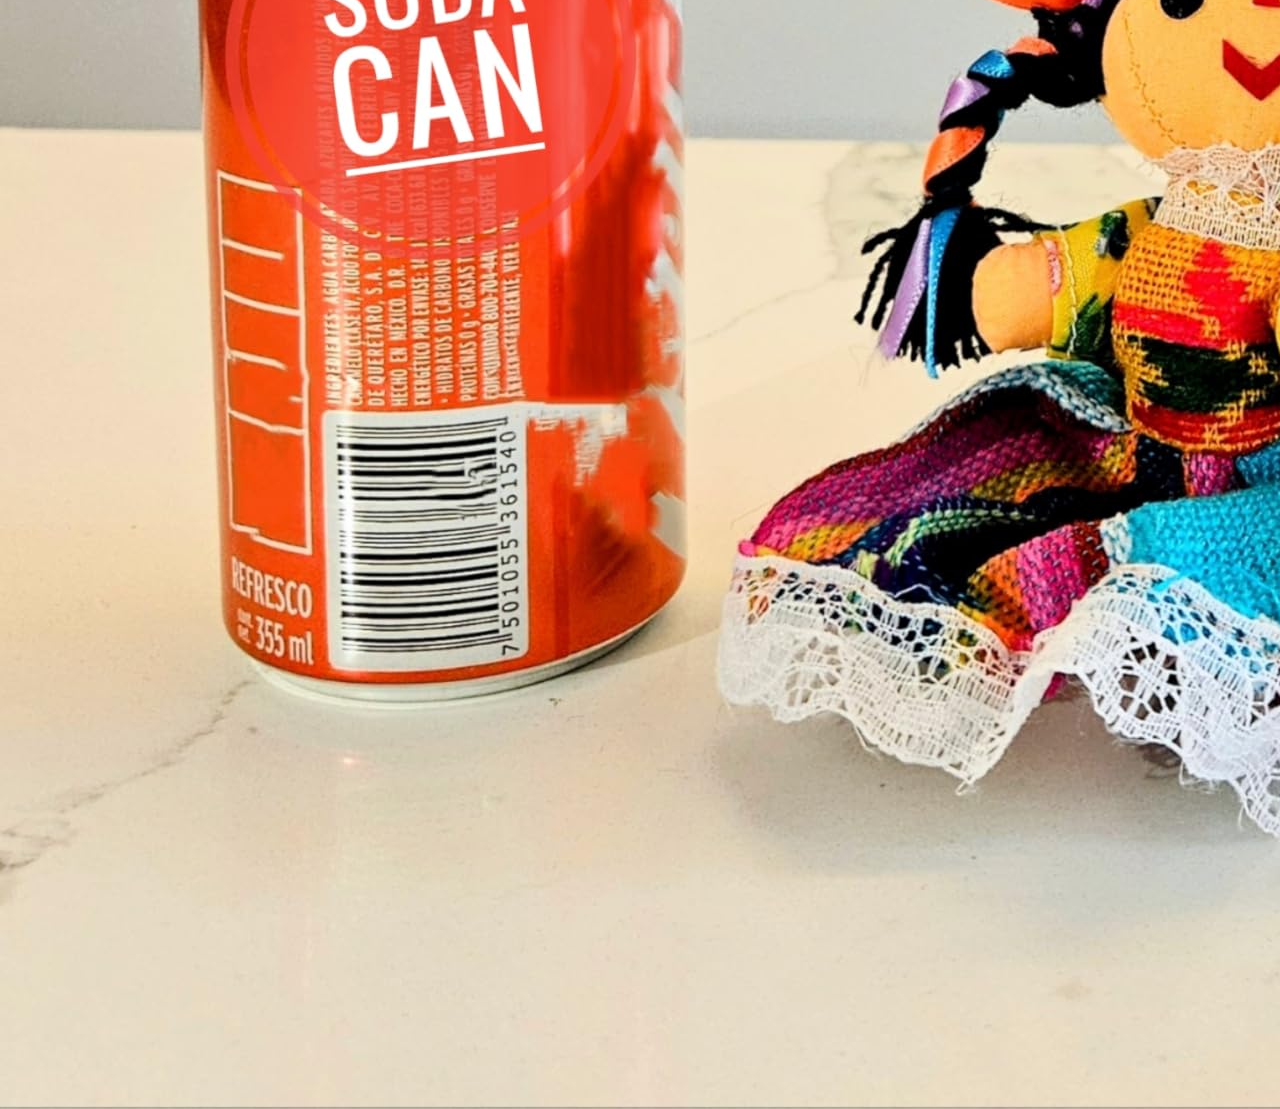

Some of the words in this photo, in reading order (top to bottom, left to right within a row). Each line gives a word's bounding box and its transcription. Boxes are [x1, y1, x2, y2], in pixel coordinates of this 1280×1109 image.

[364, 266, 384, 296] S.A.
[386, 264, 407, 289] D.R.
[502, 250, 520, 273] VER
[322, 271, 341, 305] AGUA
[342, 296, 364, 312] IV,
[410, 272, 430, 315] ENVASE:
[432, 258, 453, 314] CARBONO
[456, 266, 476, 309] GRASAS
[343, 314, 362, 347] CLASE
[383, 295, 408, 341] MÉXICO.
[412, 317, 431, 340] POR
[433, 317, 453, 333] DE
[361, 299, 387, 385] QUERÉTARO,
[389, 347, 408, 363] EN
[407, 341, 432, 406] ENERGÉTICO
[433, 335, 454, 394] HIDRATOS
[455, 341, 479, 402] PROTEÍNAS
[366, 389, 386, 406] DE
[390, 369, 409, 406] HECHO
[500, 430, 519, 524] 361540
[231, 555, 313, 619] REFRESCO
[498, 536, 519, 630] 501055
[255, 614, 285, 658] 355
[288, 630, 314, 666] ml
[501, 642, 520, 656] 7
